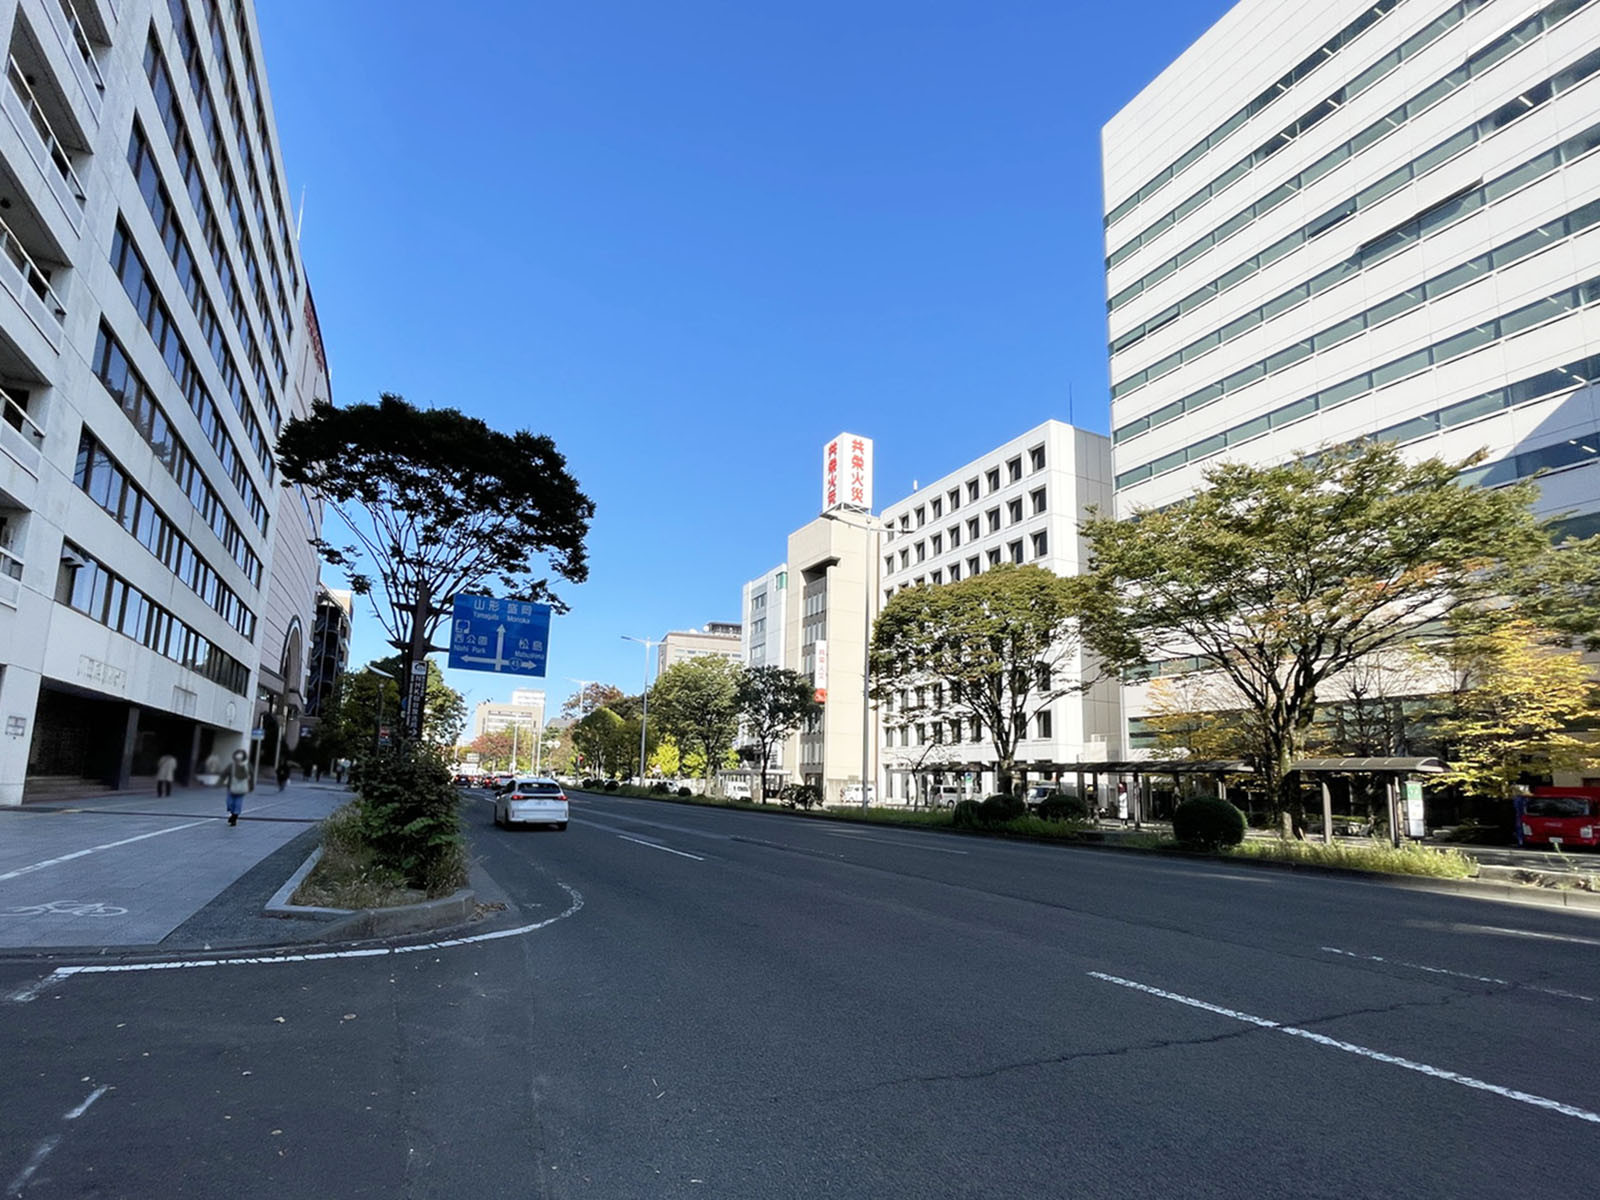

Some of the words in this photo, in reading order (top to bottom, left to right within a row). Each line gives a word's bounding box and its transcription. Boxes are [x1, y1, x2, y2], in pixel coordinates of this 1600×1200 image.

[827, 441, 838, 508] 共栄火災
[851, 439, 865, 504] 共栄火災
[473, 599, 500, 611] 山形
[454, 634, 488, 646] 西公園
[518, 638, 543, 652] 松島
[472, 645, 487, 654] Park
